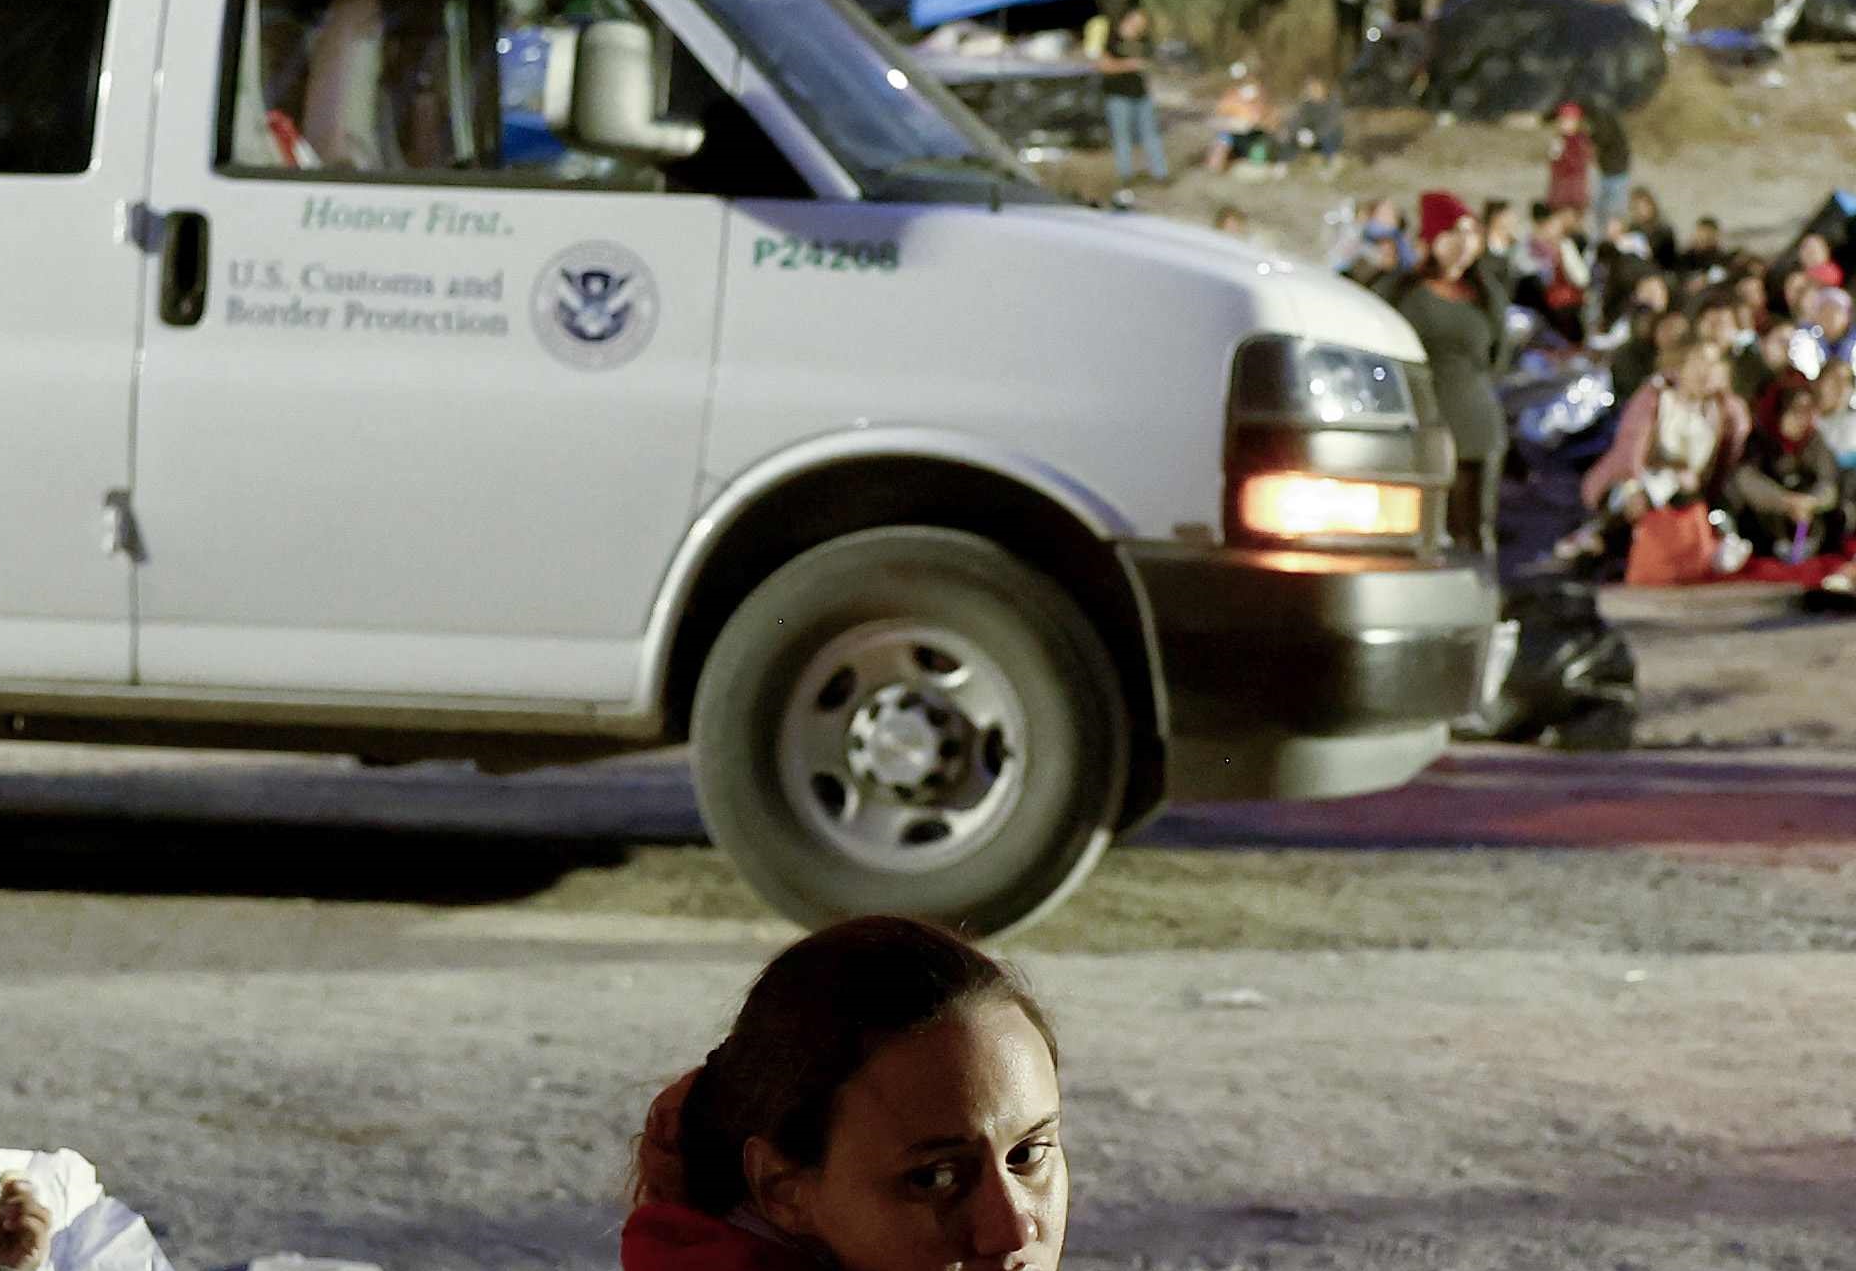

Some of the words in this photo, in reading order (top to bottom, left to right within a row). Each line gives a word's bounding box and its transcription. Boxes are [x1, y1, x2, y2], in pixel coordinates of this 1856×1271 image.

[301, 196, 414, 232] Honor
[228, 260, 291, 291] U.S.
[300, 262, 435, 296] Customs
[448, 270, 504, 301] and
[225, 295, 332, 328] Border
[344, 299, 510, 336] Protection
